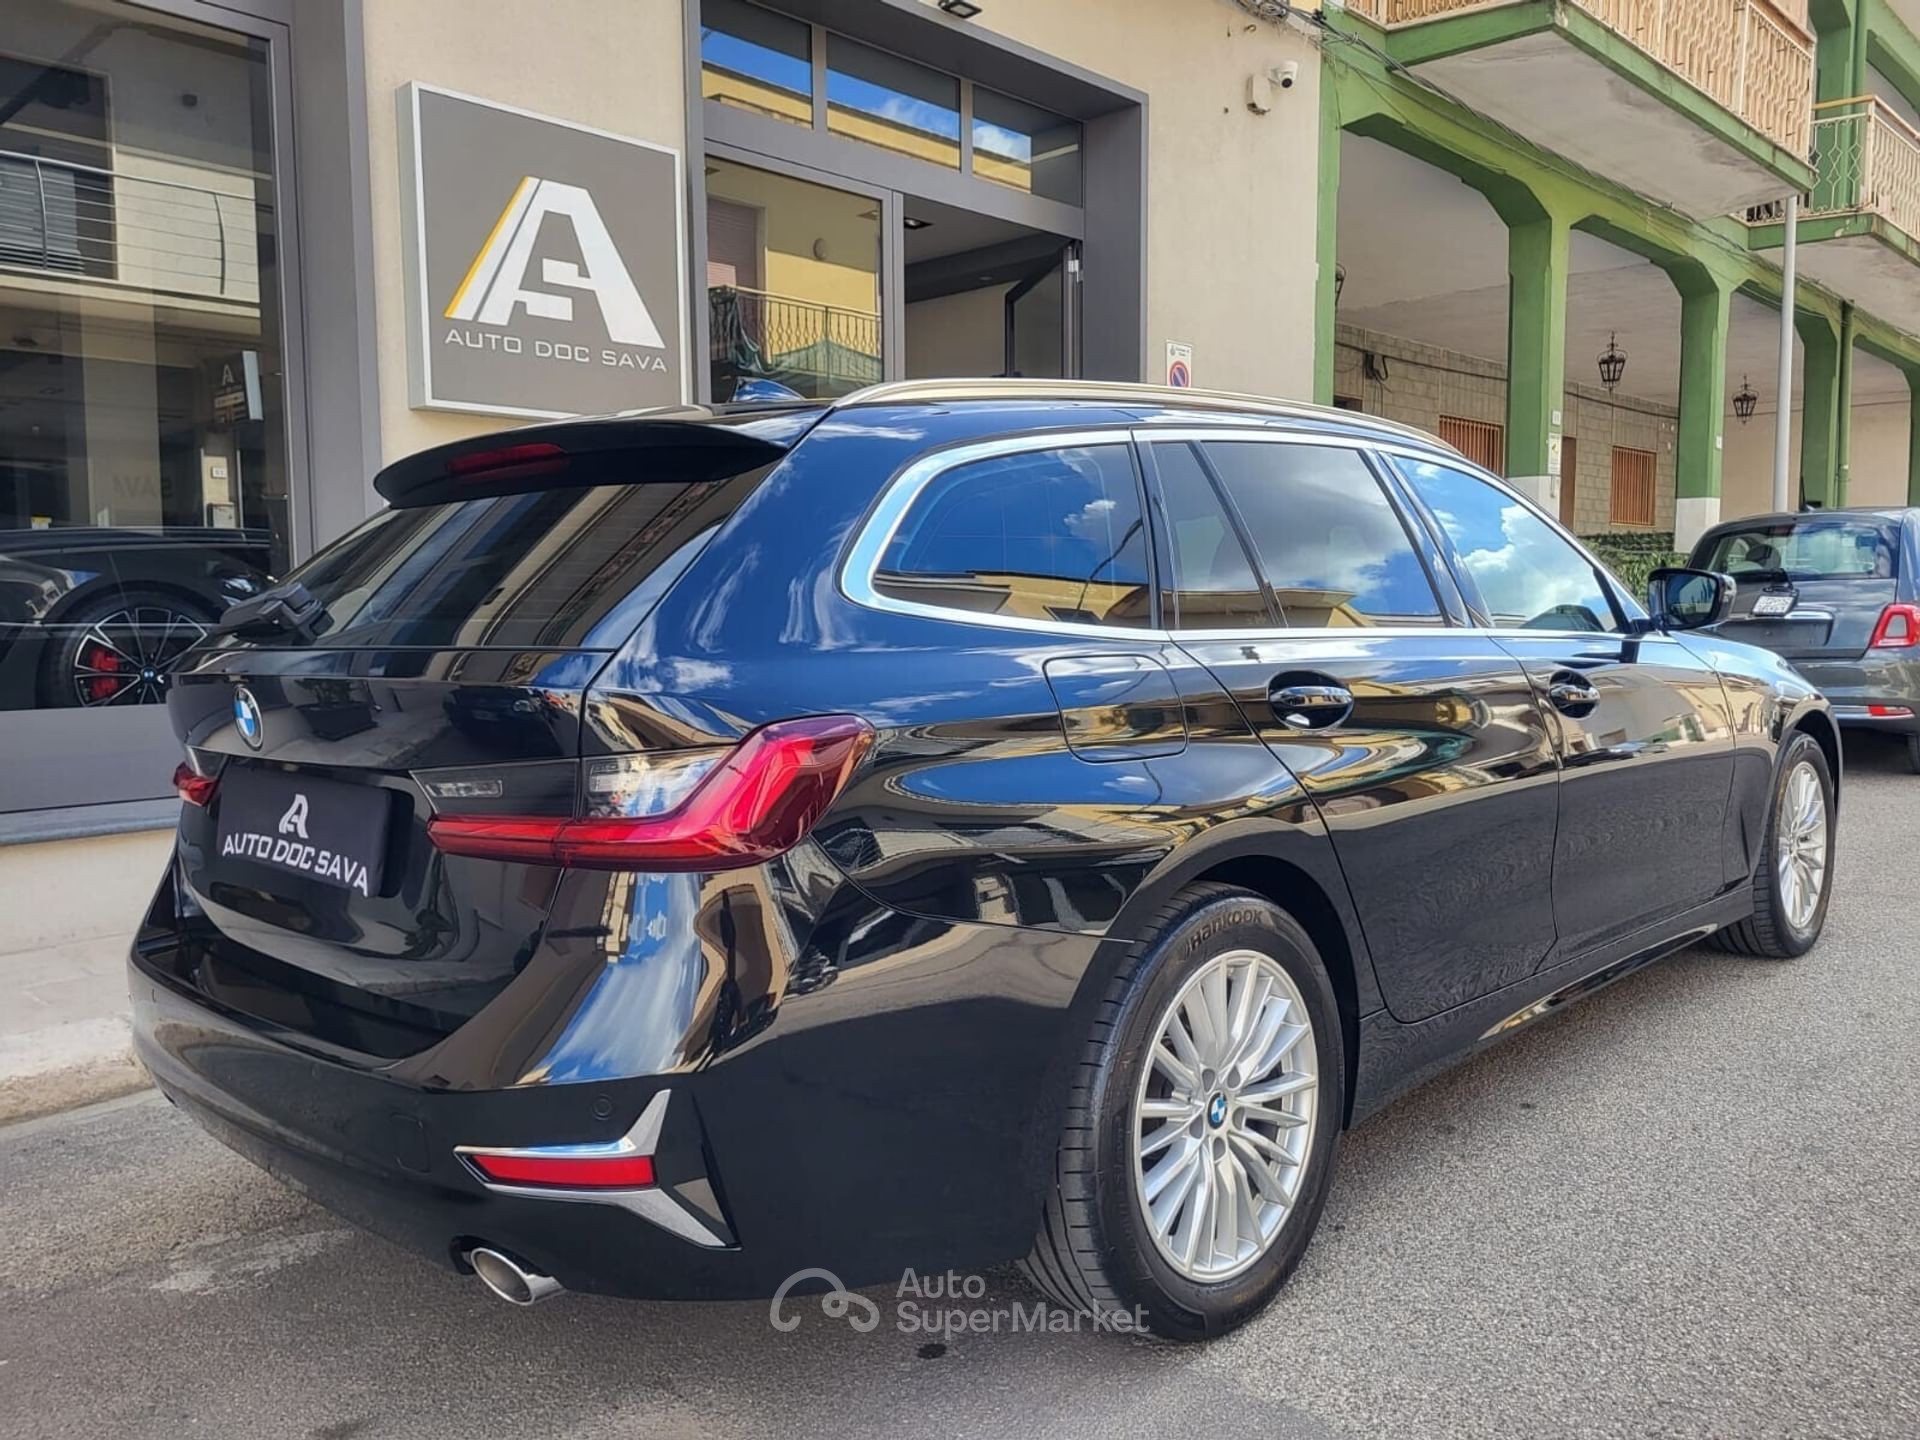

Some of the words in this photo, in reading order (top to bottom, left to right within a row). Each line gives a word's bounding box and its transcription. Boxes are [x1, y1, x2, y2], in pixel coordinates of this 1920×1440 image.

[444, 328, 522, 353] AUTO
[535, 340, 590, 362] DOC
[601, 349, 667, 372] SAVA
[222, 832, 273, 858] AUTO
[271, 839, 316, 870] DOC
[314, 850, 368, 898] SAVA
